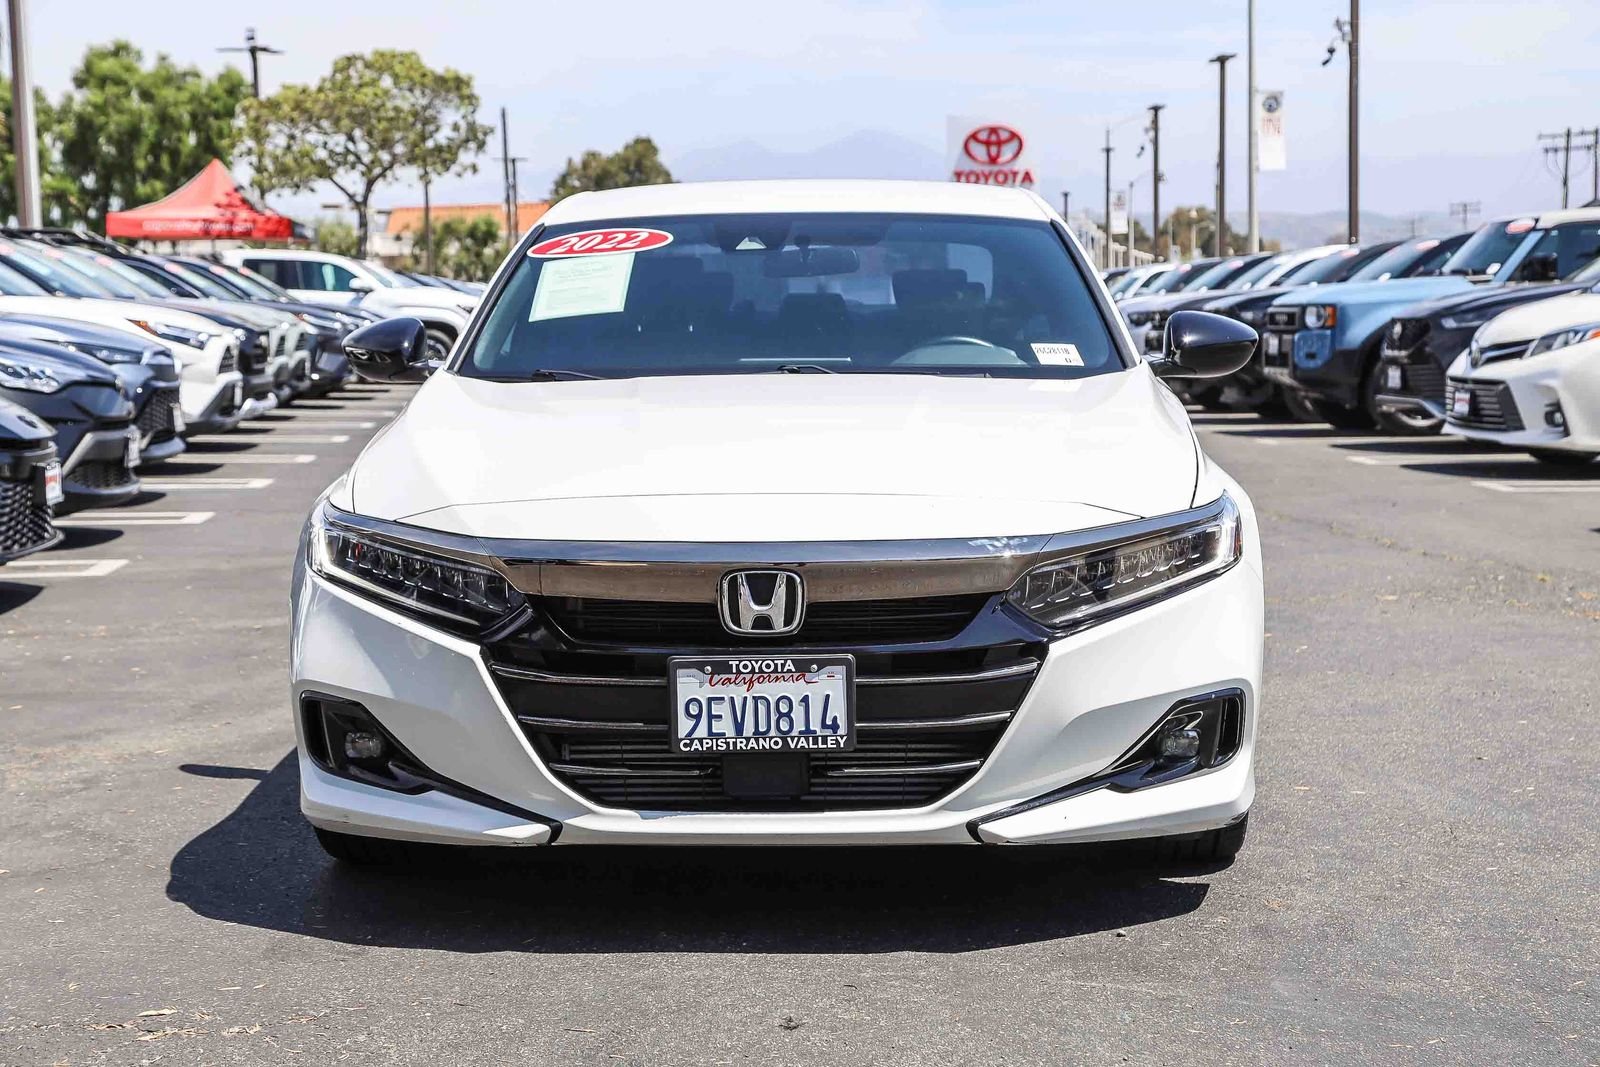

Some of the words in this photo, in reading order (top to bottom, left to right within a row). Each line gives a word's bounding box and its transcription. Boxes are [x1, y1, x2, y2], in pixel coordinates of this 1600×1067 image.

[954, 170, 1033, 186] TOYOTA
[546, 231, 650, 254] 2022
[728, 660, 796, 673] TOYOTA
[708, 671, 819, 692] California
[684, 693, 840, 737] 9EVD814
[679, 737, 783, 752] CAPISTRANO
[787, 736, 848, 749] VALLEY
